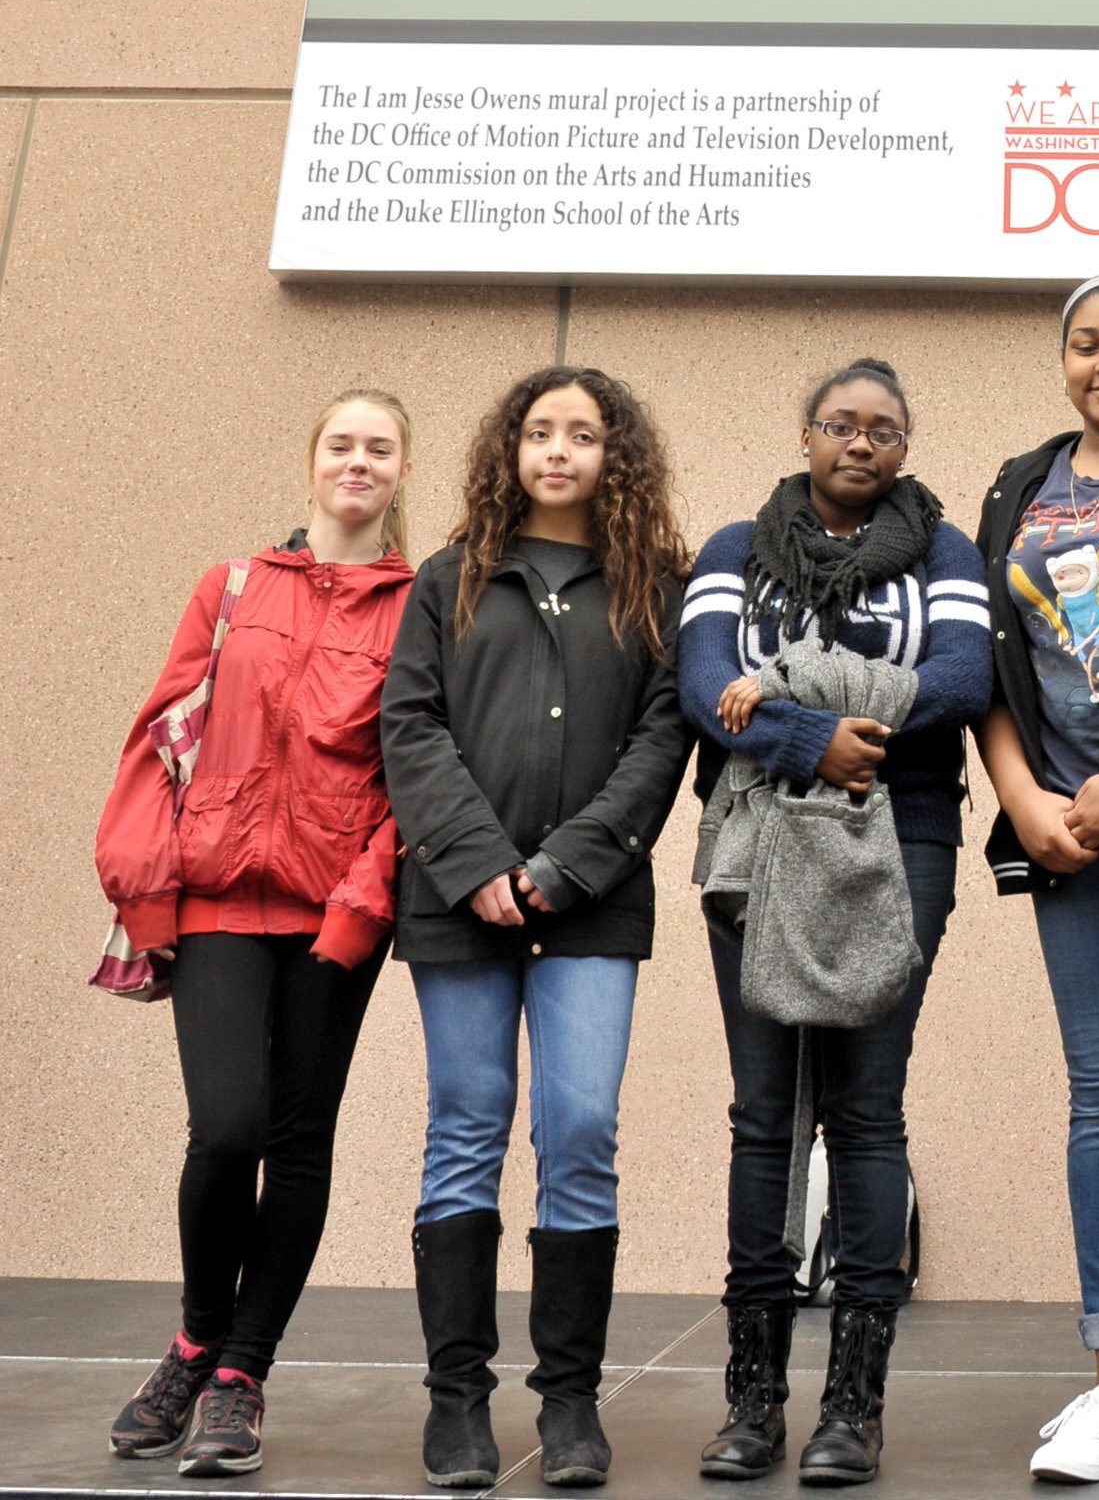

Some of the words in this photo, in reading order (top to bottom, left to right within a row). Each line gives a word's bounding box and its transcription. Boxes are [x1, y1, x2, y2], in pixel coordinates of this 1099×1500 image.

[320, 85, 356, 107] The
[363, 86, 371, 107] I
[377, 93, 407, 108] am
[412, 87, 463, 114] Jesse
[471, 87, 540, 109] Owens
[548, 88, 607, 110] mural
[615, 89, 685, 118] project
[693, 89, 708, 111] is
[715, 96, 725, 111] a
[732, 90, 852, 120] partnership
[859, 90, 881, 112] of
[1005, 101, 1055, 125] WE
[314, 122, 344, 145] the
[352, 123, 385, 145] DC
[392, 123, 450, 146] Office
[458, 124, 479, 146] of
[485, 125, 559, 147] Motion
[567, 125, 638, 148] Picture
[648, 126, 685, 148] and
[694, 126, 799, 149] Television
[808, 127, 953, 158] Development,
[309, 160, 339, 183] the
[347, 161, 381, 183] DC
[387, 161, 515, 185] Commission
[523, 170, 548, 185] on
[556, 163, 587, 186] the
[594, 164, 636, 186] Arts
[643, 164, 681, 186] and
[689, 165, 810, 188] Humanities
[302, 198, 340, 221] and
[348, 199, 378, 222] the
[386, 199, 442, 223] Duke
[450, 200, 545, 231] Ellington
[553, 201, 622, 225] School
[630, 201, 652, 225] of
[659, 202, 689, 225] the
[696, 203, 740, 226] Arts
